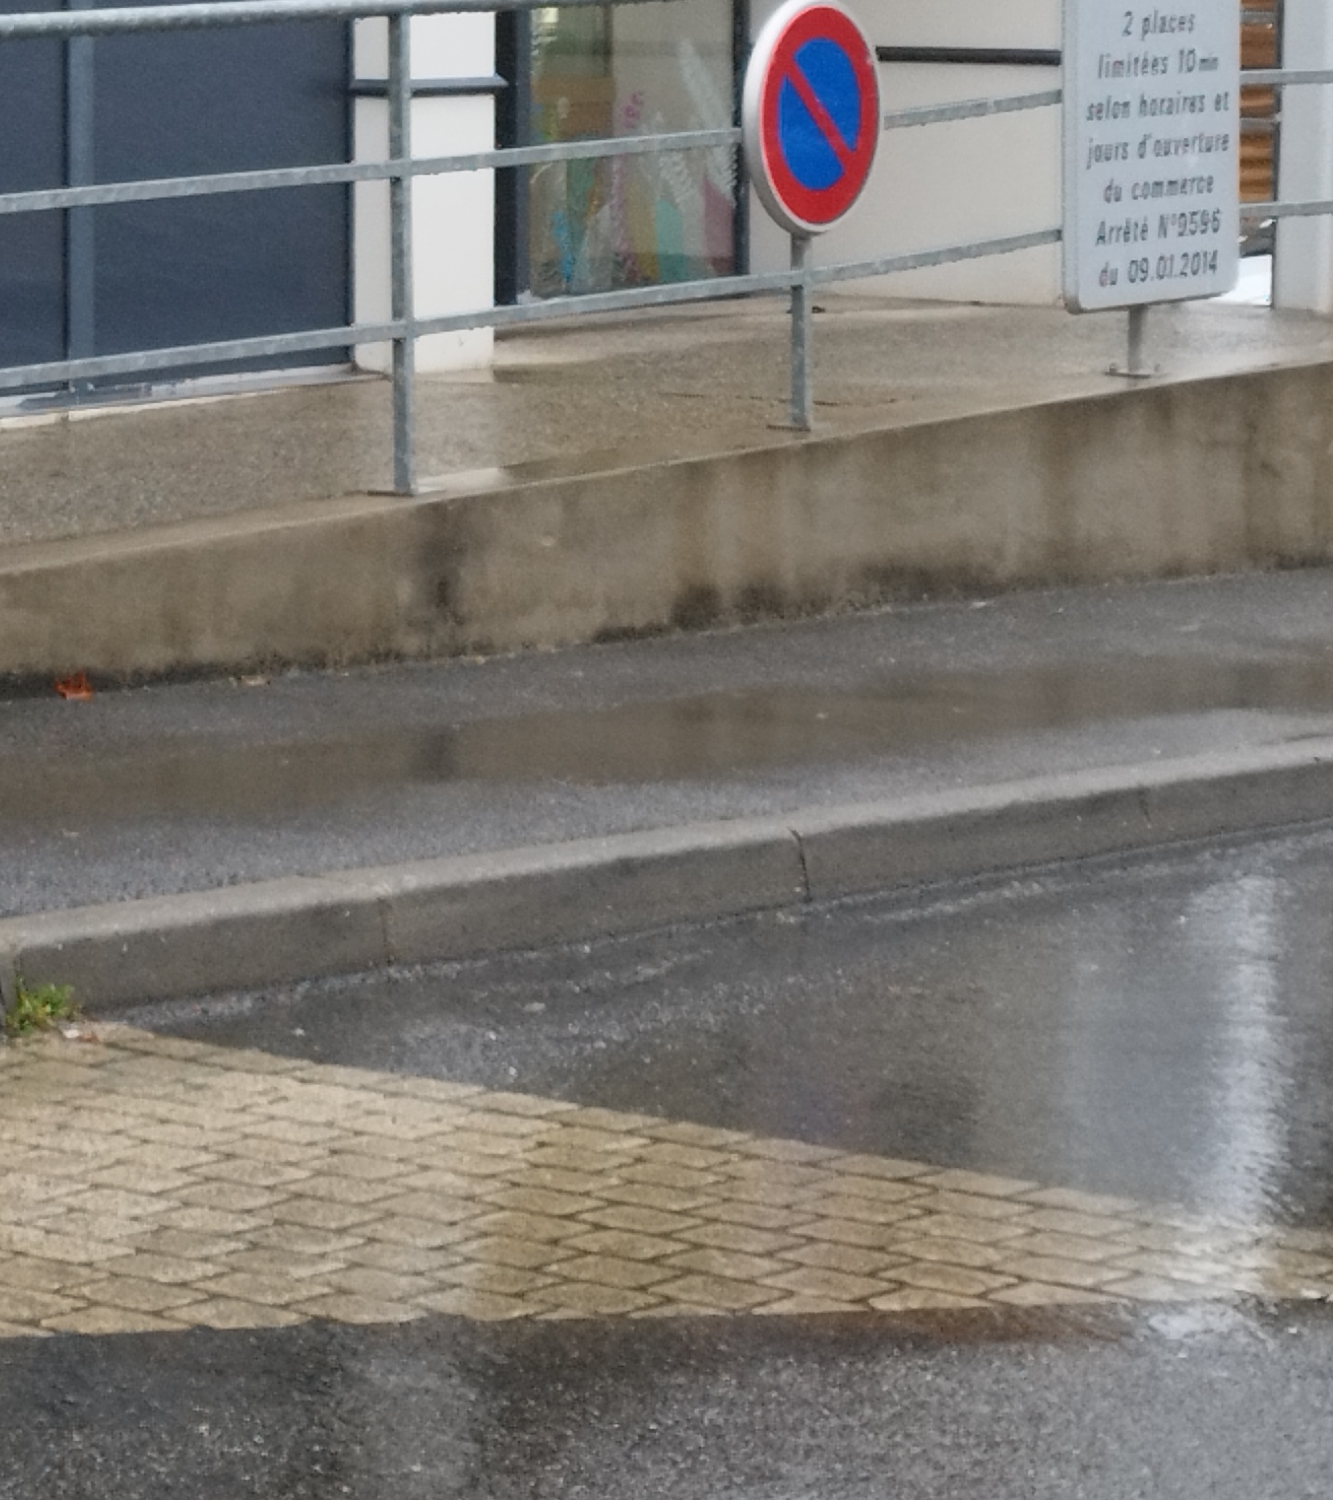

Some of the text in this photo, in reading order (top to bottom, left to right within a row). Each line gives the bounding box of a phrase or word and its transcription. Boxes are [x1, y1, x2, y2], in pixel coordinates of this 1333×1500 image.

[1122, 9, 1196, 41] 2 places
[1097, 51, 1169, 79] limitées
[1178, 48, 1196, 74] 10
[1086, 90, 1229, 121] selon horaires et
[1086, 132, 1229, 171] jours d'ouverture
[1103, 174, 1214, 204] du commerce
[1095, 215, 1148, 247] Arrêté
[1098, 249, 1219, 288] du 09.01.2014
